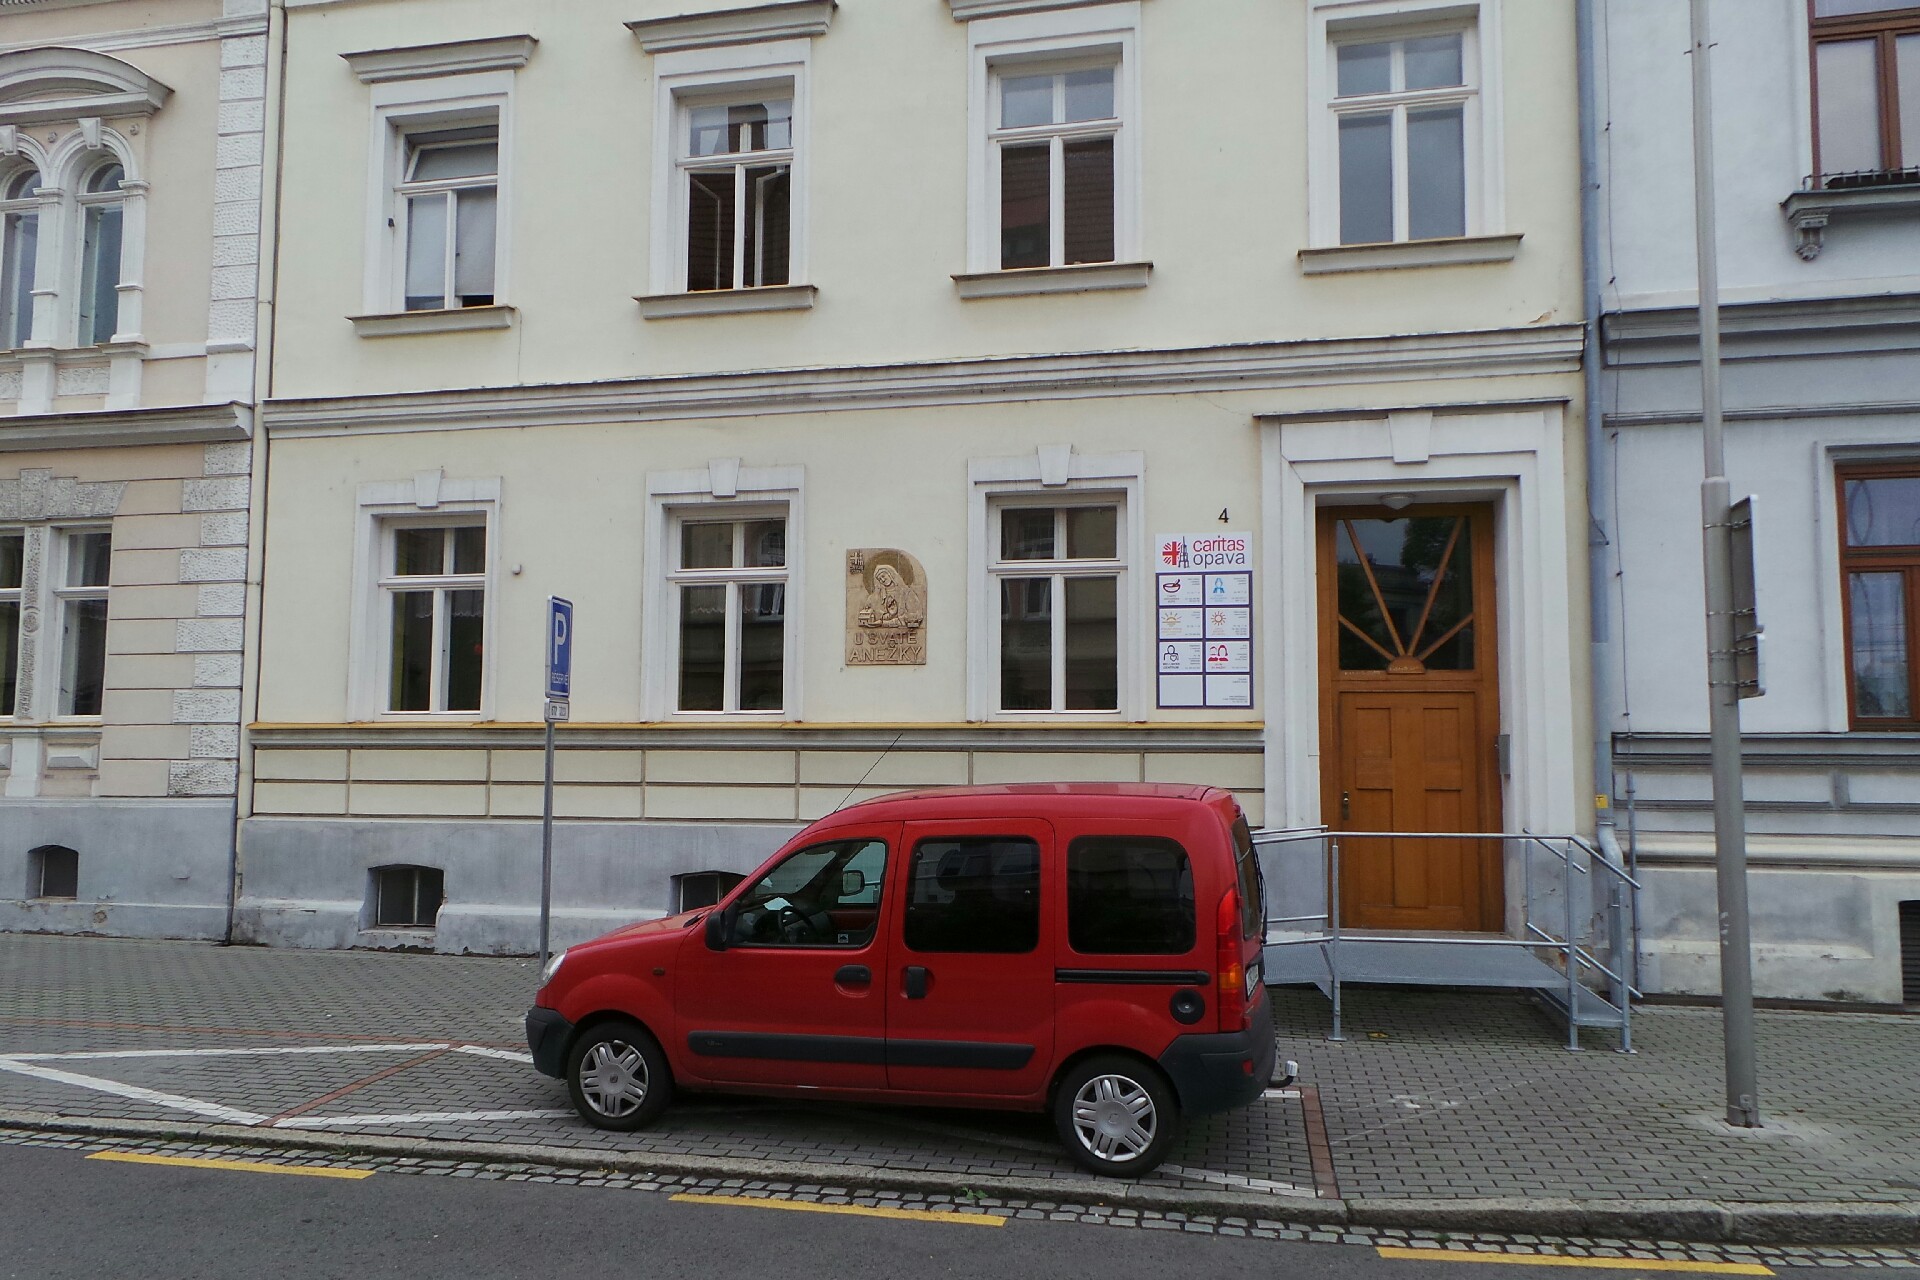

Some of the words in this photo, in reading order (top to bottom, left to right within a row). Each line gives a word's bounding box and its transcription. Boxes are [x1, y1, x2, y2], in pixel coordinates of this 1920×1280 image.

[1218, 508, 1229, 523] 4
[1193, 535, 1245, 552] caritas
[1193, 552, 1245, 569] opava
[554, 612, 567, 665] P
[854, 633, 864, 645] U
[849, 643, 922, 662] ANEŽKY
